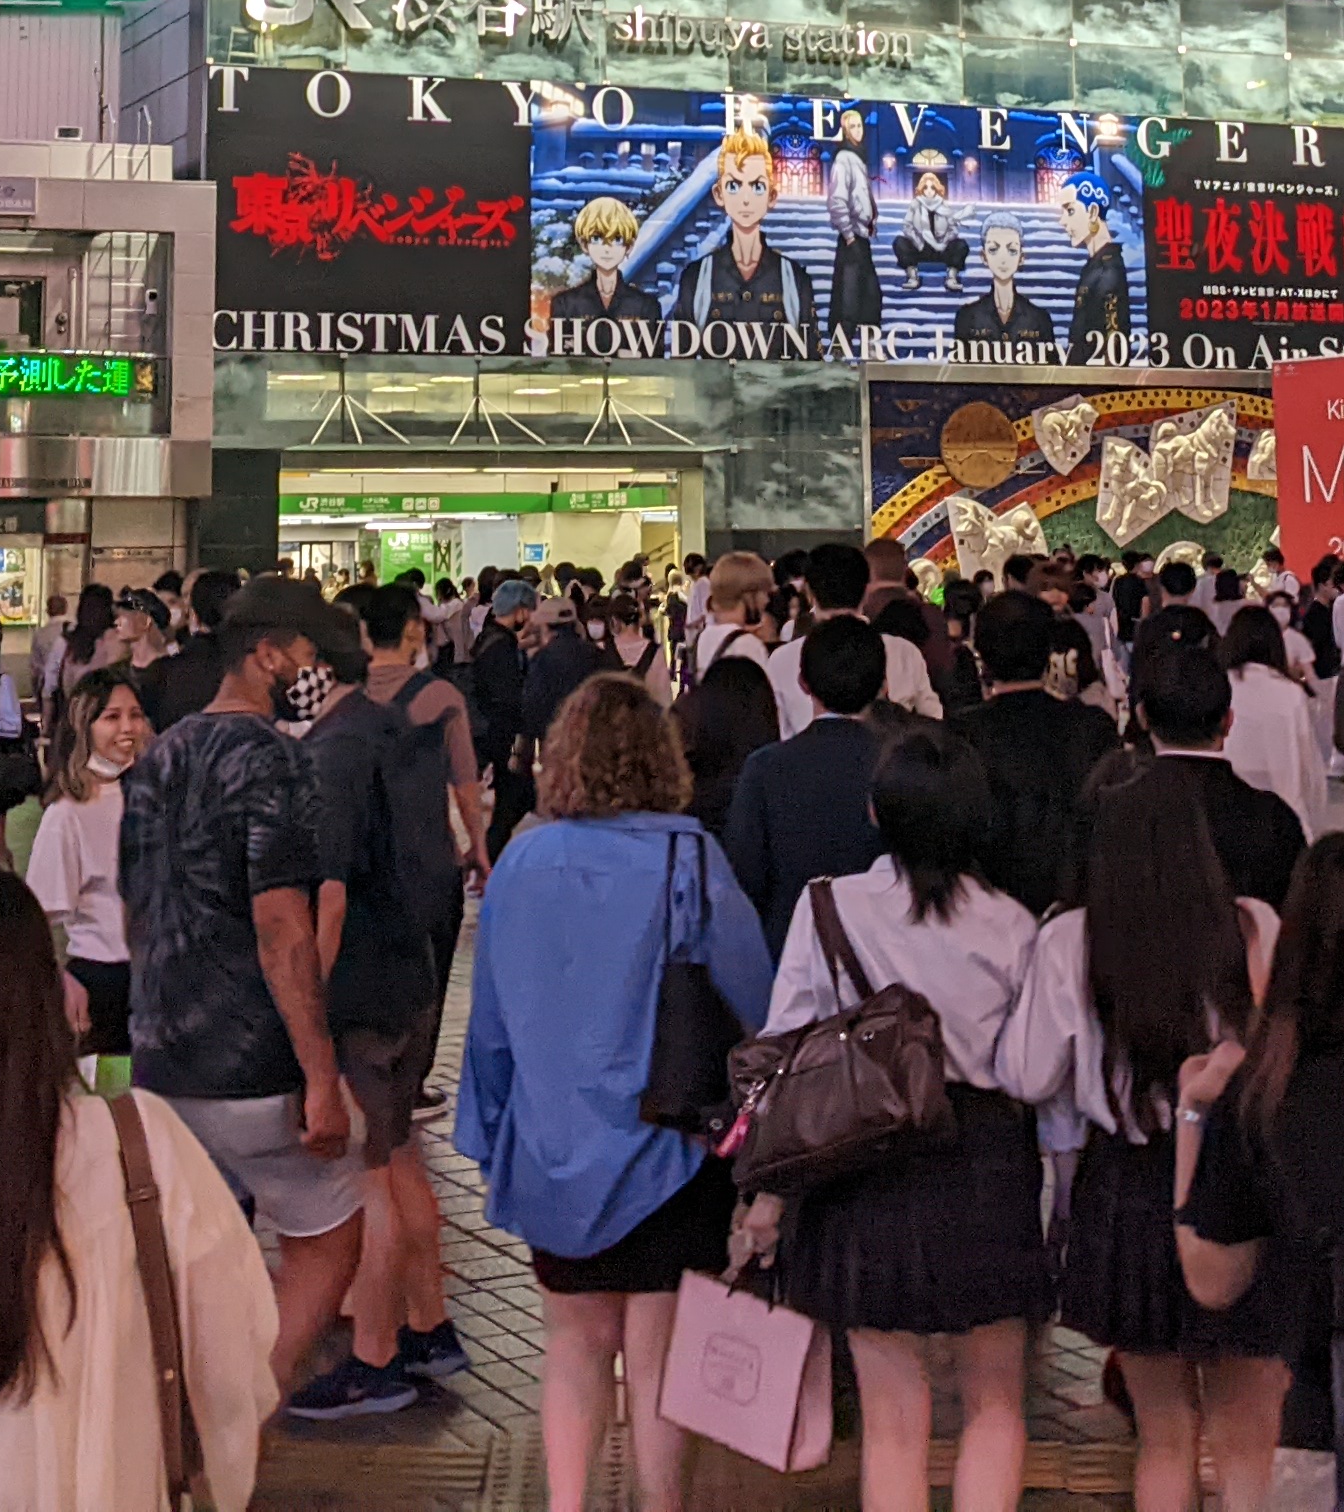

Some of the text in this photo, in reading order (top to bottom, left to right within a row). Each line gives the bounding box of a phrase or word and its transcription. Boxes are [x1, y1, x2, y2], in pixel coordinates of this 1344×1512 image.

[614, 5, 773, 53] shibuya
[784, 21, 913, 57] station
[209, 65, 635, 131] TOKYO
[212, 309, 507, 356] CHRISTMAS
[523, 317, 811, 360] SHOWDOWN
[827, 324, 915, 363] ARC
[927, 329, 1073, 366] January
[1085, 330, 1170, 368] 2023
[1183, 333, 1237, 370] On
